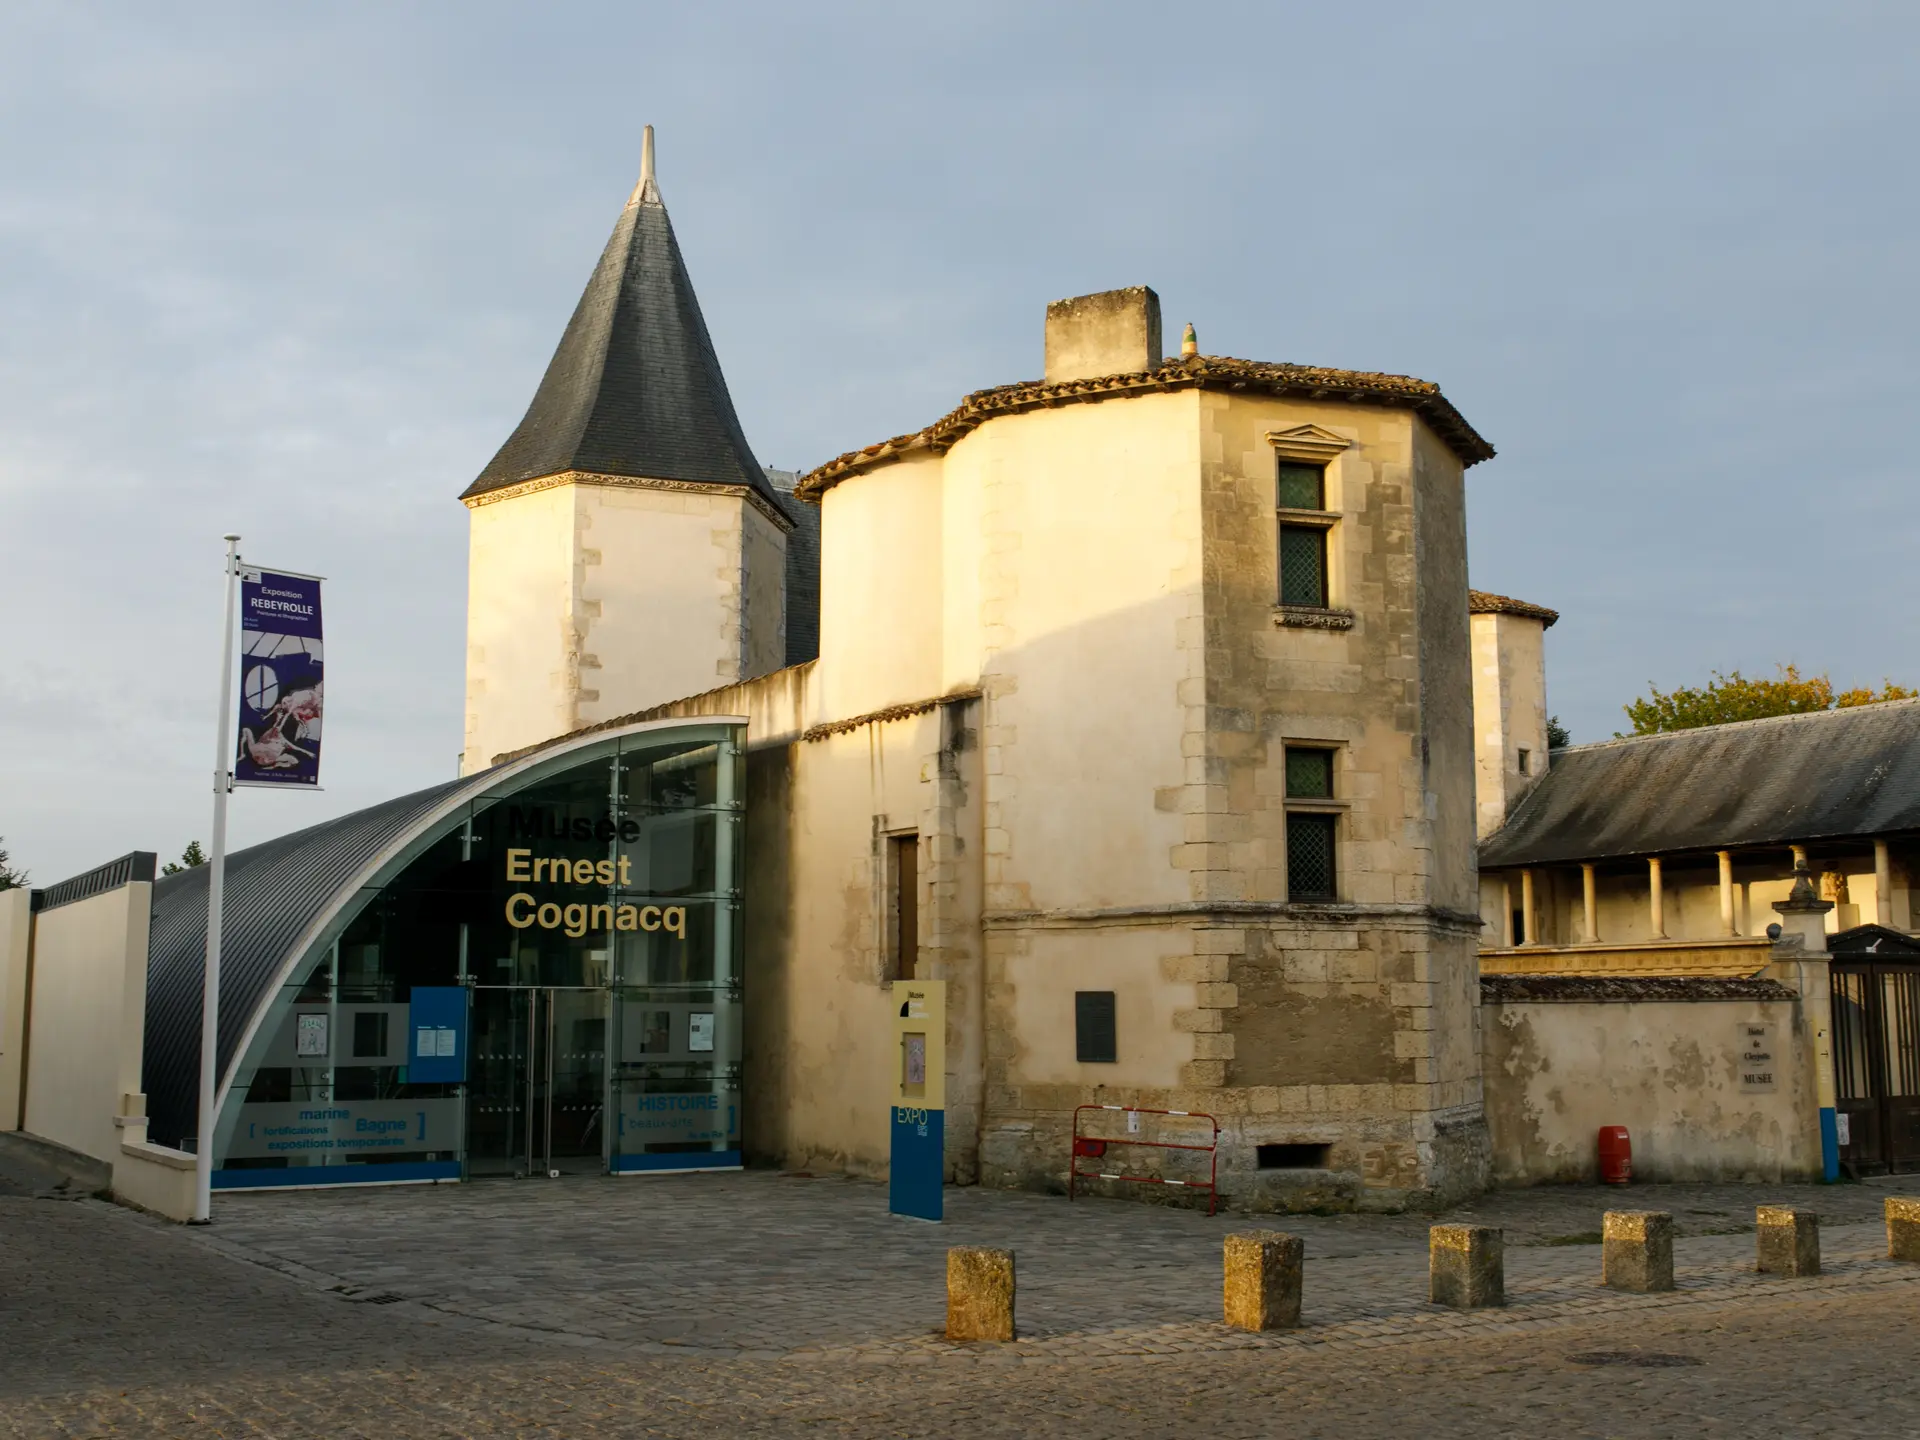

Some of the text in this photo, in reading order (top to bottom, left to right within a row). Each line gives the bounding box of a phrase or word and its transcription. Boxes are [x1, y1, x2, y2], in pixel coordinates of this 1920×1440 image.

[261, 586, 303, 599] Exposition
[251, 598, 313, 615] REBEYROLLE
[508, 804, 641, 843] Musée
[506, 848, 632, 885] Ernest
[505, 892, 686, 939] Cognacq
[1753, 1039, 1761, 1048] de
[1744, 1072, 1773, 1084] MUSÉE
[638, 1095, 719, 1111] HISTOIRE
[299, 1108, 350, 1120] marine
[897, 1106, 928, 1126] EXPO
[356, 1118, 407, 1134] Bagne
[629, 1117, 694, 1129] beaux-arts
[264, 1126, 329, 1137] fortifications
[268, 1137, 405, 1151] expositions temporaires
